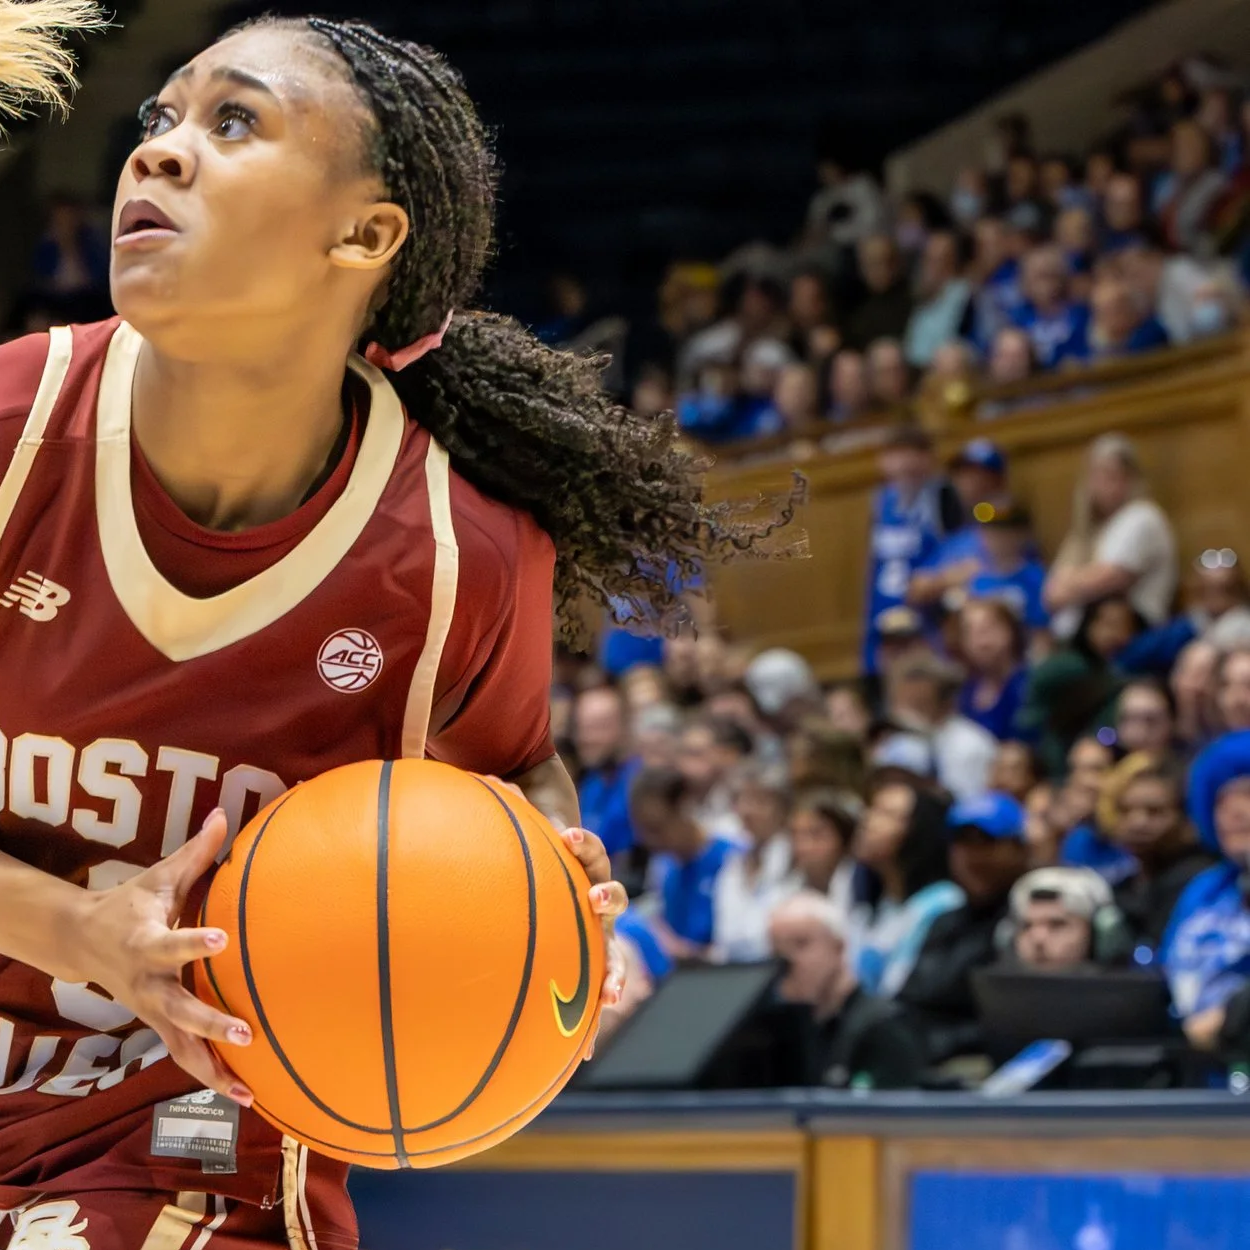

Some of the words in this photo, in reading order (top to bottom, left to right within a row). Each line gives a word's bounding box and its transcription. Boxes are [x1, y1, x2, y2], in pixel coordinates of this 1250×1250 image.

[325, 650, 380, 668] ACC
[169, 1104, 188, 1113] new
[188, 1104, 225, 1116] balance
